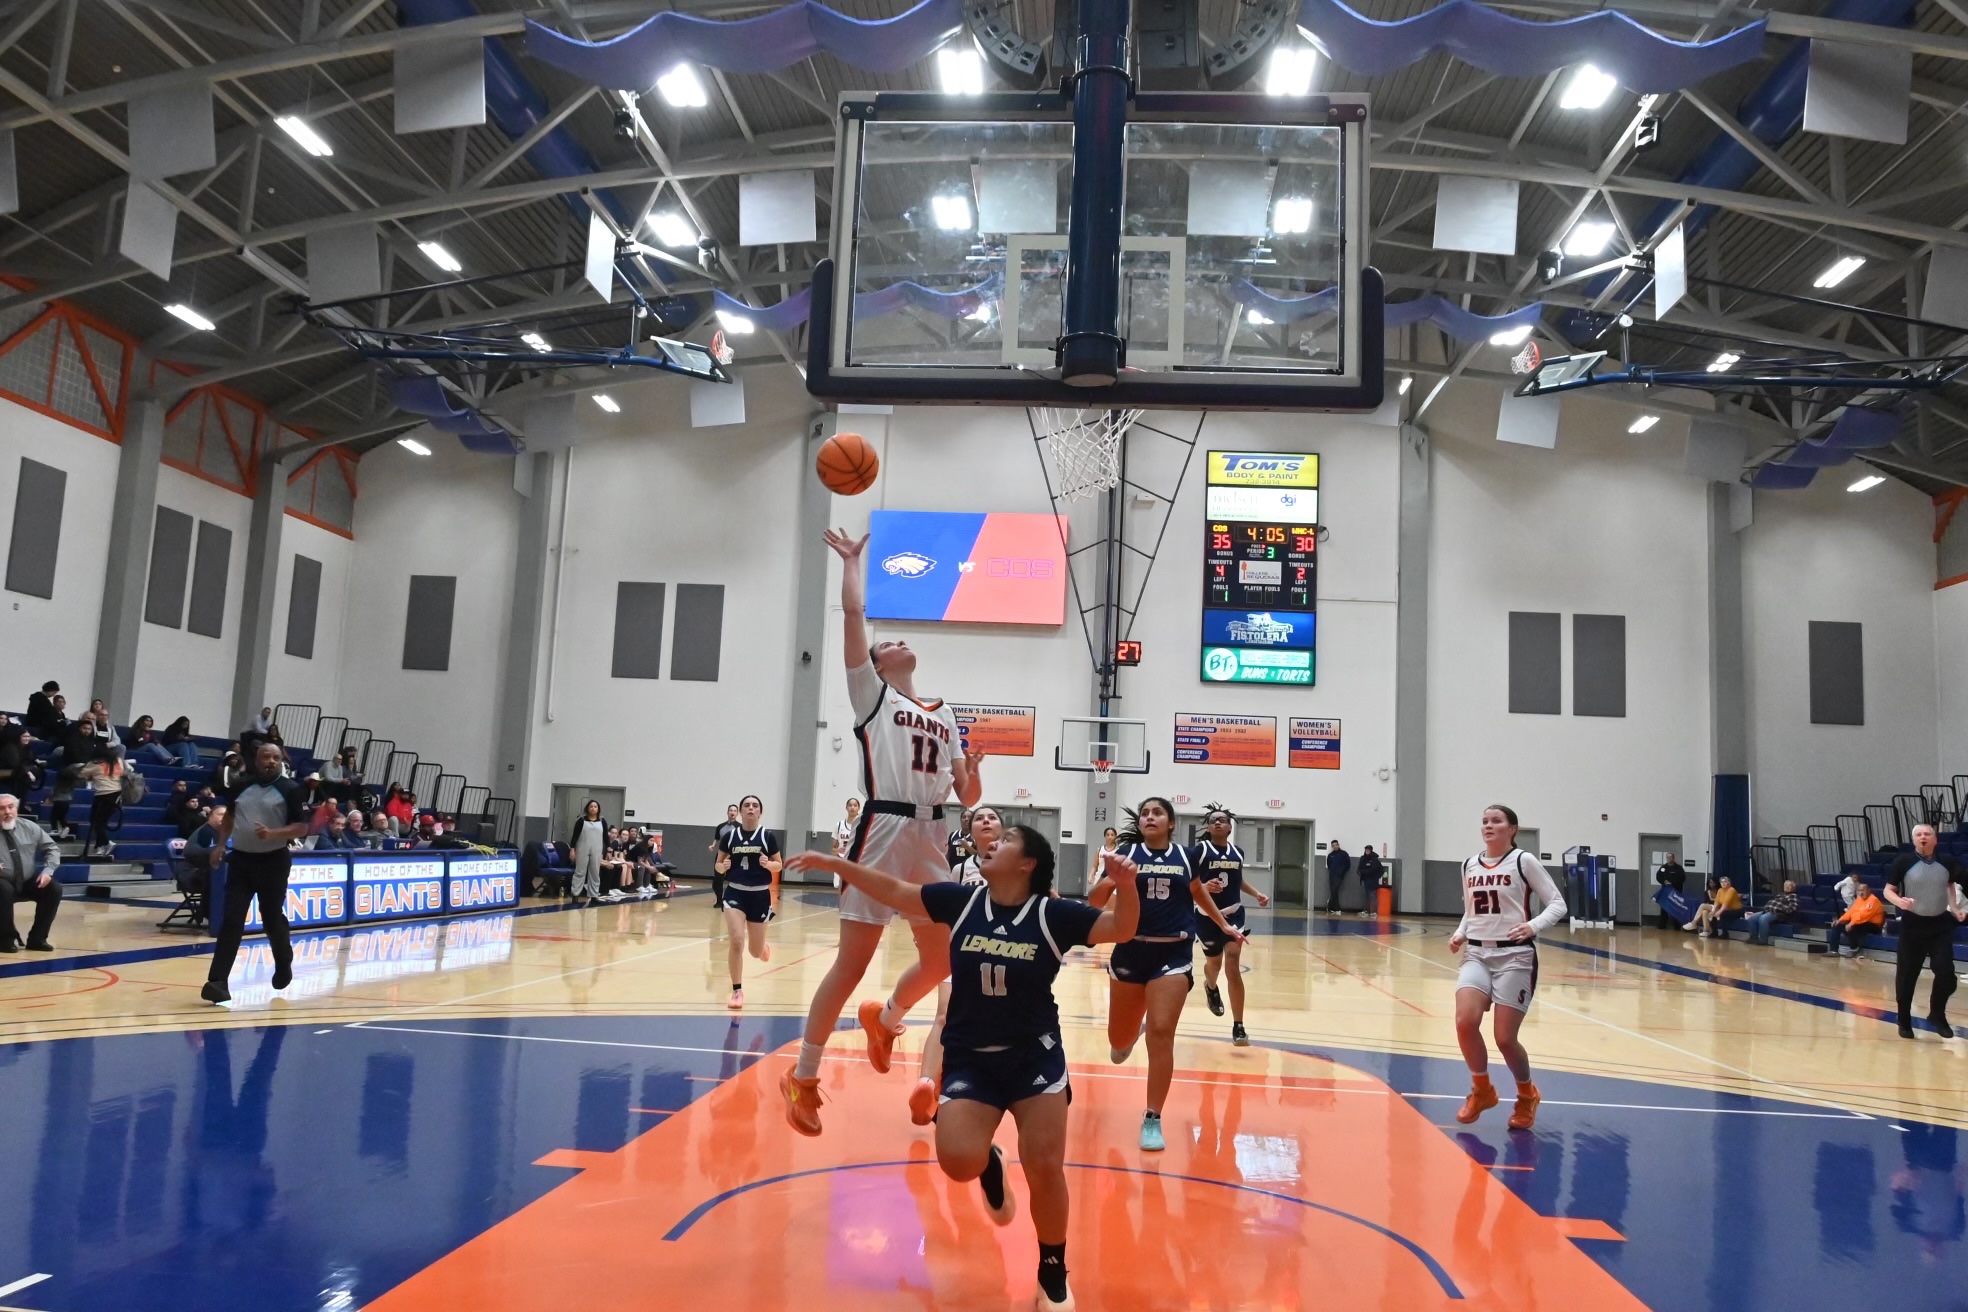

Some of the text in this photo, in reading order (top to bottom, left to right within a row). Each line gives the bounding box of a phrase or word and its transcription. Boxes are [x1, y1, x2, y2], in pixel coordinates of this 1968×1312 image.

[1222, 454, 1306, 472] TOM'S
[1281, 493, 1297, 507] dgi
[1212, 534, 1232, 549] 35
[1248, 527, 1285, 542] 4:05
[1296, 537, 1315, 552] 30
[1268, 547, 1275, 558] 3
[986, 558, 1054, 578] COS
[1216, 565, 1225, 577] 4
[1297, 568, 1306, 580] 2
[1117, 642, 1140, 660] 27
[1276, 669, 1311, 681] TORTS
[893, 710, 950, 745] GIANTS
[1216, 718, 1261, 726] BASKETBALL
[1296, 721, 1332, 729] WOMEN'S
[1292, 729, 1338, 737] VOLLEYBALL
[911, 734, 939, 775] 11
[732, 846, 762, 855] LEMOORE
[365, 863, 434, 878] HOME OF THE
[457, 861, 509, 874] HOME OF THE
[740, 856, 750, 871] 4
[1137, 863, 1184, 876] LEMOORE
[1208, 860, 1240, 870] LEMOORE
[310, 867, 334, 880] THE
[1467, 874, 1512, 888] GIANTS
[449, 877, 515, 907] GIANTS
[1146, 877, 1171, 900] 15
[355, 881, 442, 915] GIANTS
[1473, 890, 1501, 915] 21
[960, 934, 1039, 961] LEMOORE
[980, 962, 1007, 997] 11
